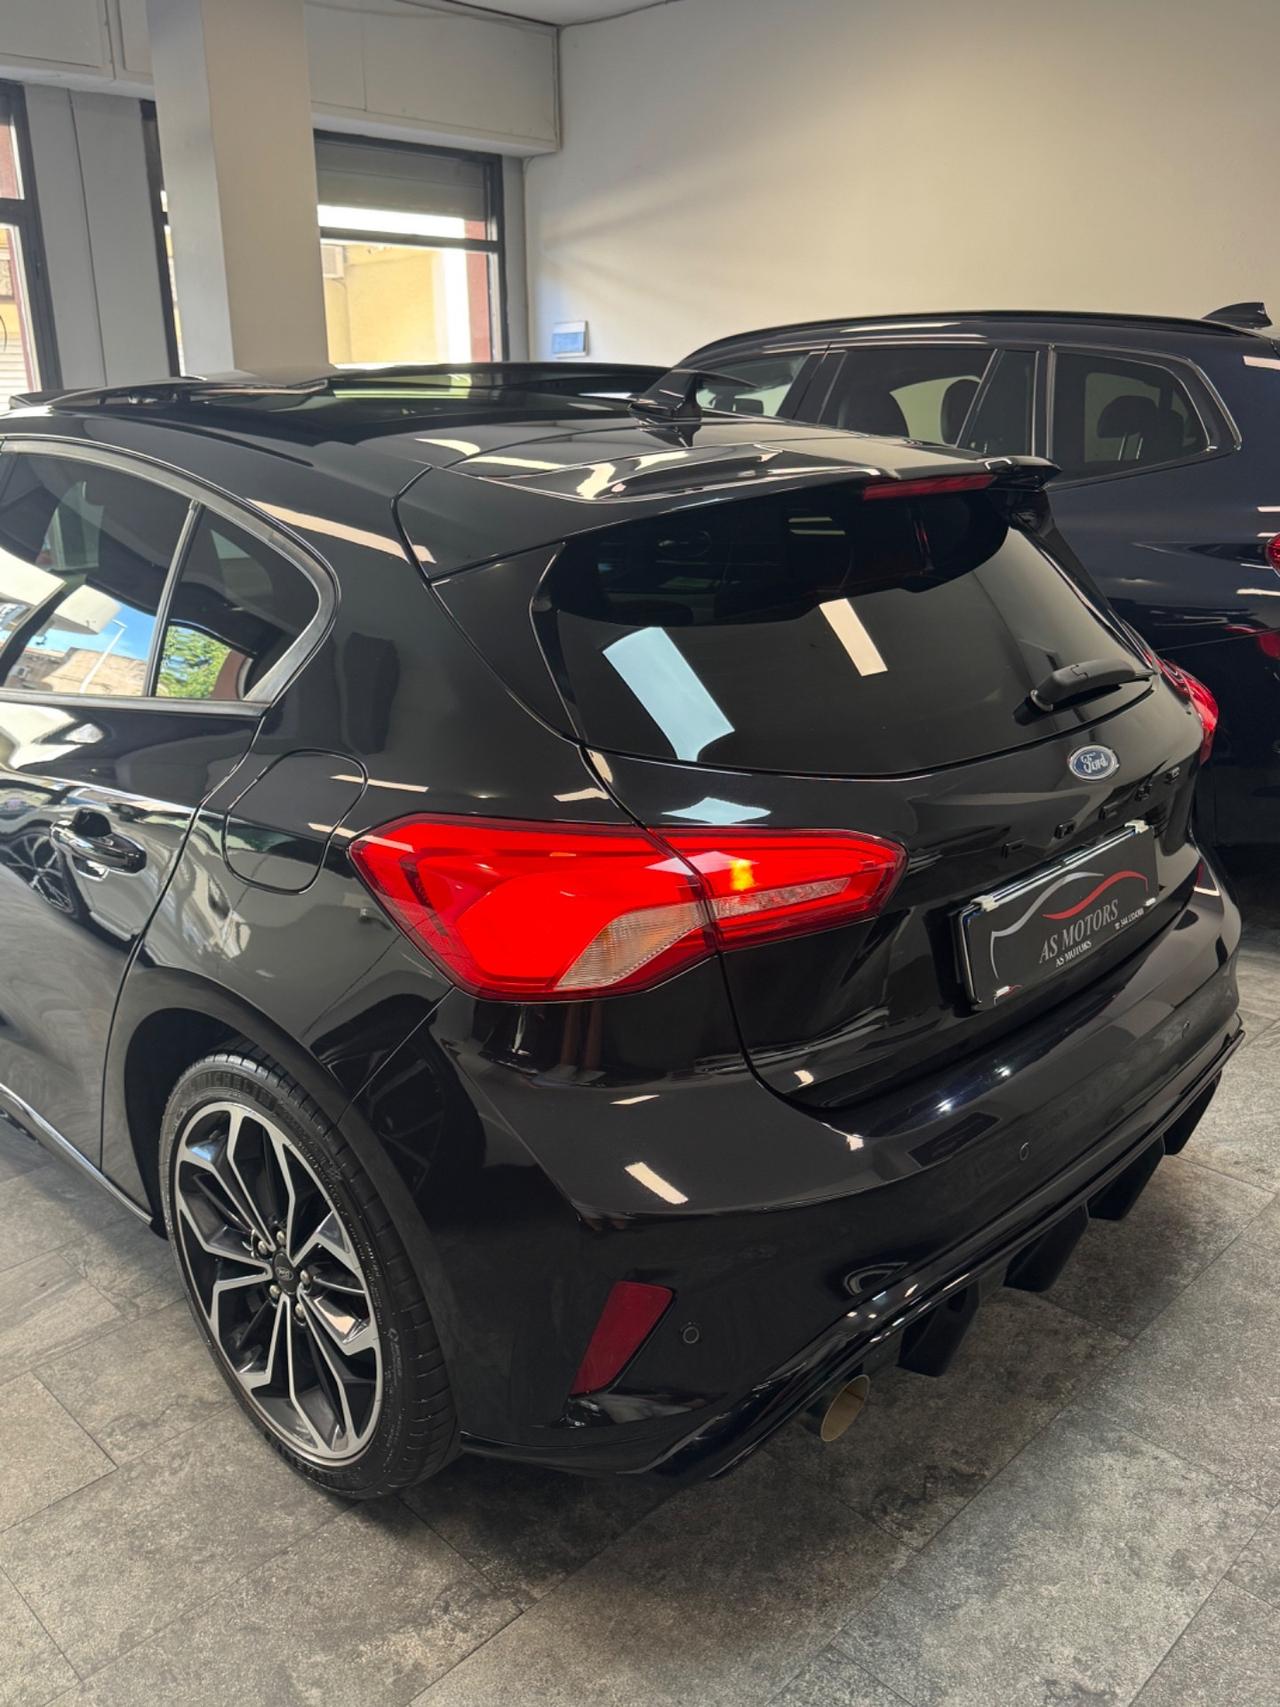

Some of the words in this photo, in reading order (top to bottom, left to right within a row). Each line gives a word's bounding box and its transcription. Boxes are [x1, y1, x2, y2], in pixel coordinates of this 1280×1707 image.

[1080, 752, 1109, 774] Ford
[1039, 935, 1059, 964] AS
[1062, 899, 1118, 951] MOTORS
[1055, 955, 1065, 968] AS
